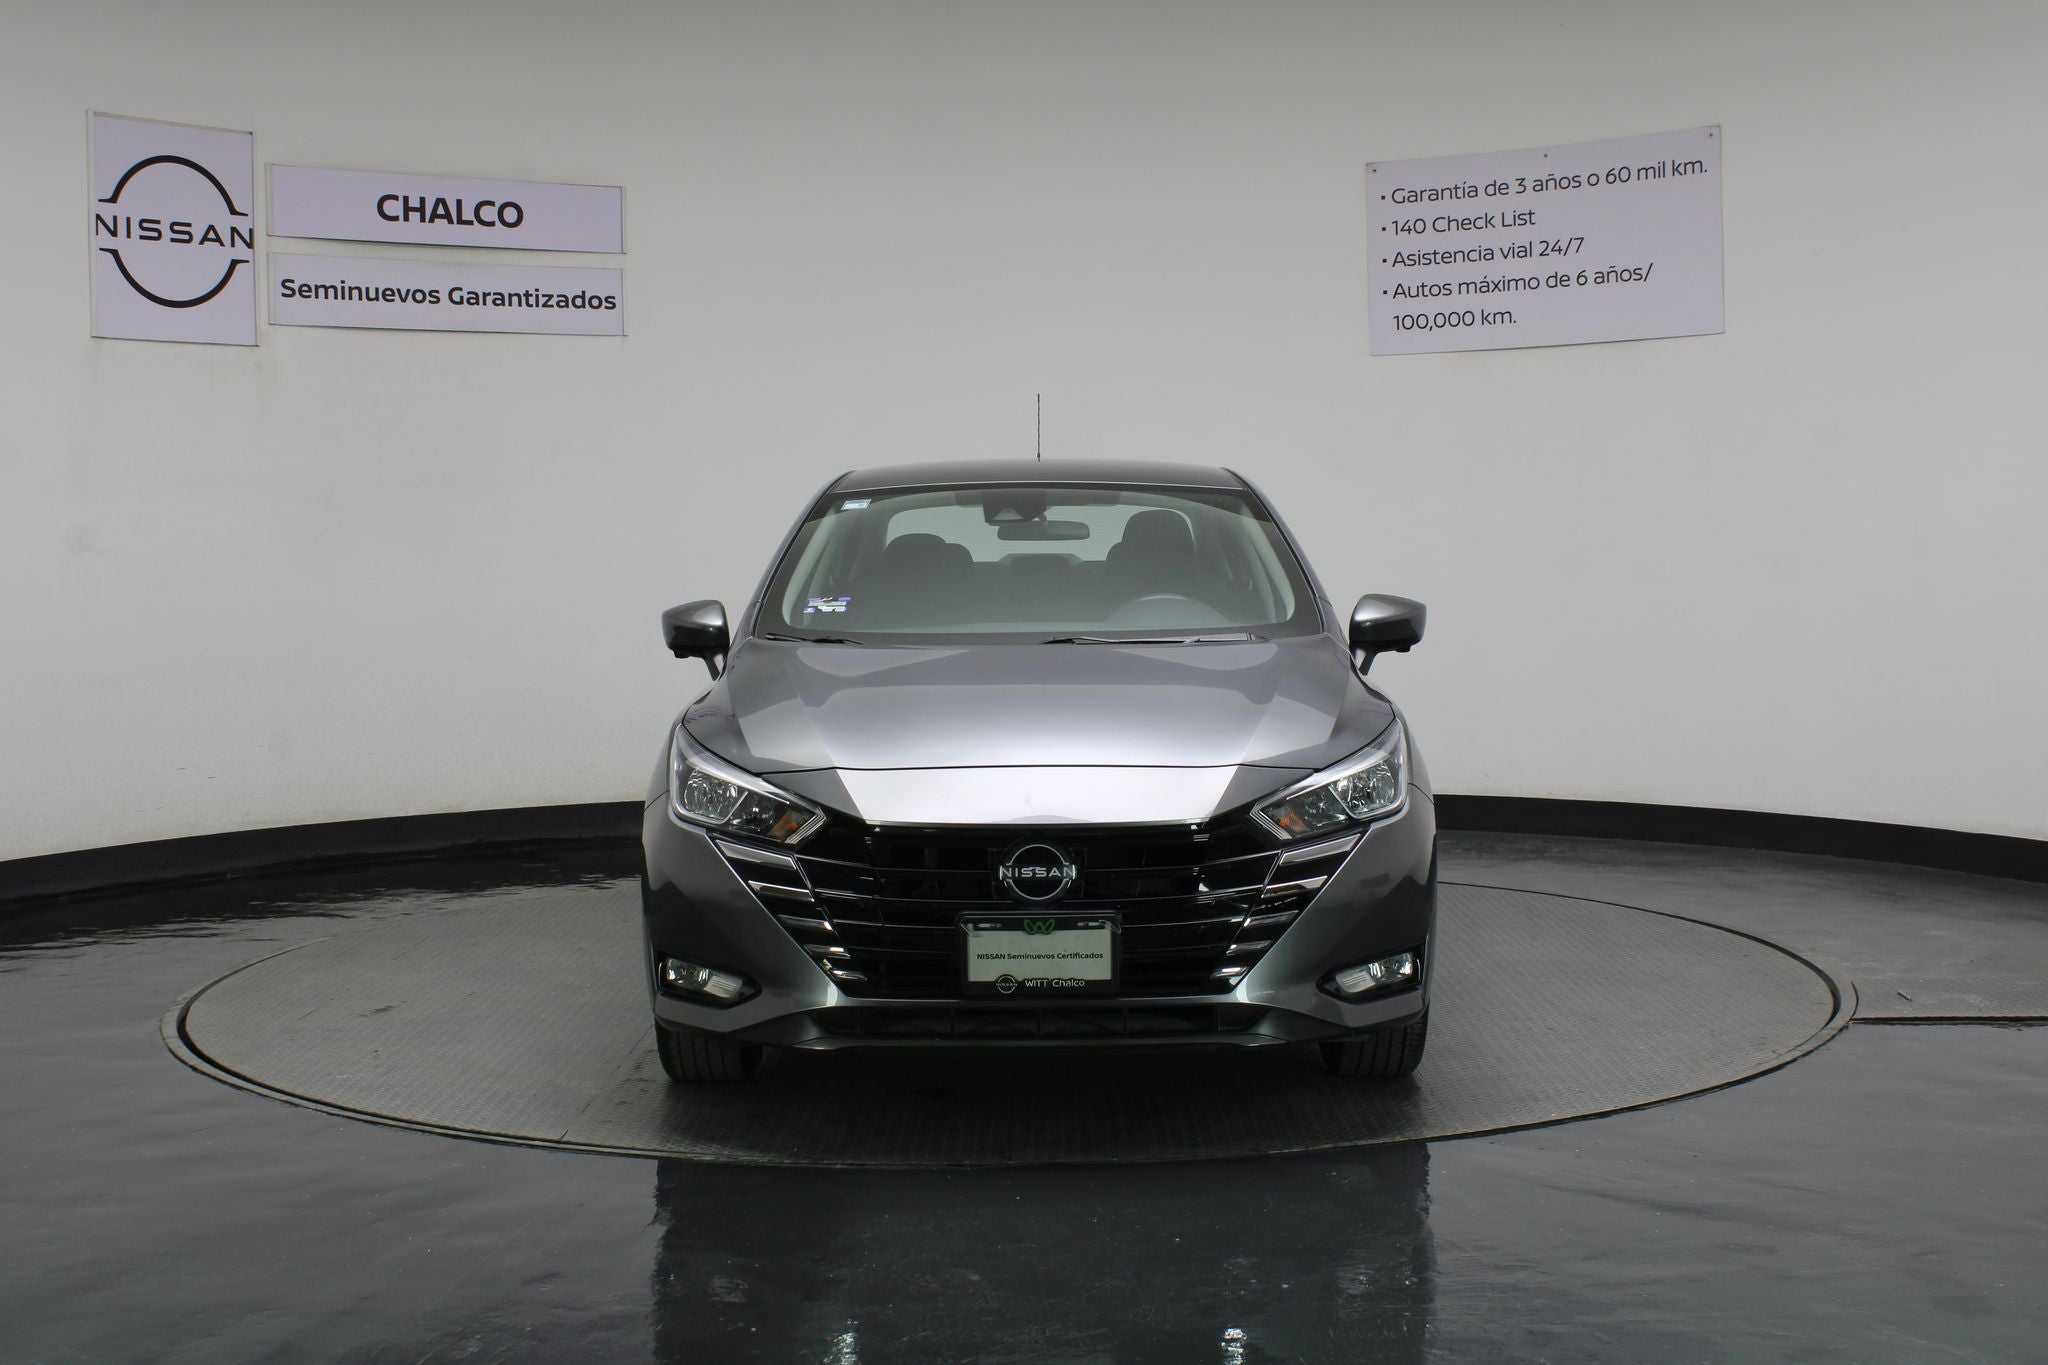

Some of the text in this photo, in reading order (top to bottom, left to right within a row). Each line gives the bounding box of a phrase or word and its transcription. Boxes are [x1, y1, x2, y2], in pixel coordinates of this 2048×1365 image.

[1391, 158, 1707, 204] Garantía de 3 años o 60 mil km.
[377, 193, 524, 229] CHALCO
[1391, 209, 1536, 236] 140 Check List
[96, 213, 254, 249] NISSAN
[1392, 236, 1585, 268] Asistencia vial 24/7
[280, 278, 617, 310] Seminuevos Garantizados
[1393, 263, 1653, 300] Autos máximo de 6 años/
[1393, 309, 1517, 332] 100,000 km.
[1000, 865, 1076, 880] NISSAN
[1025, 978, 1085, 987] WITT Chalco
